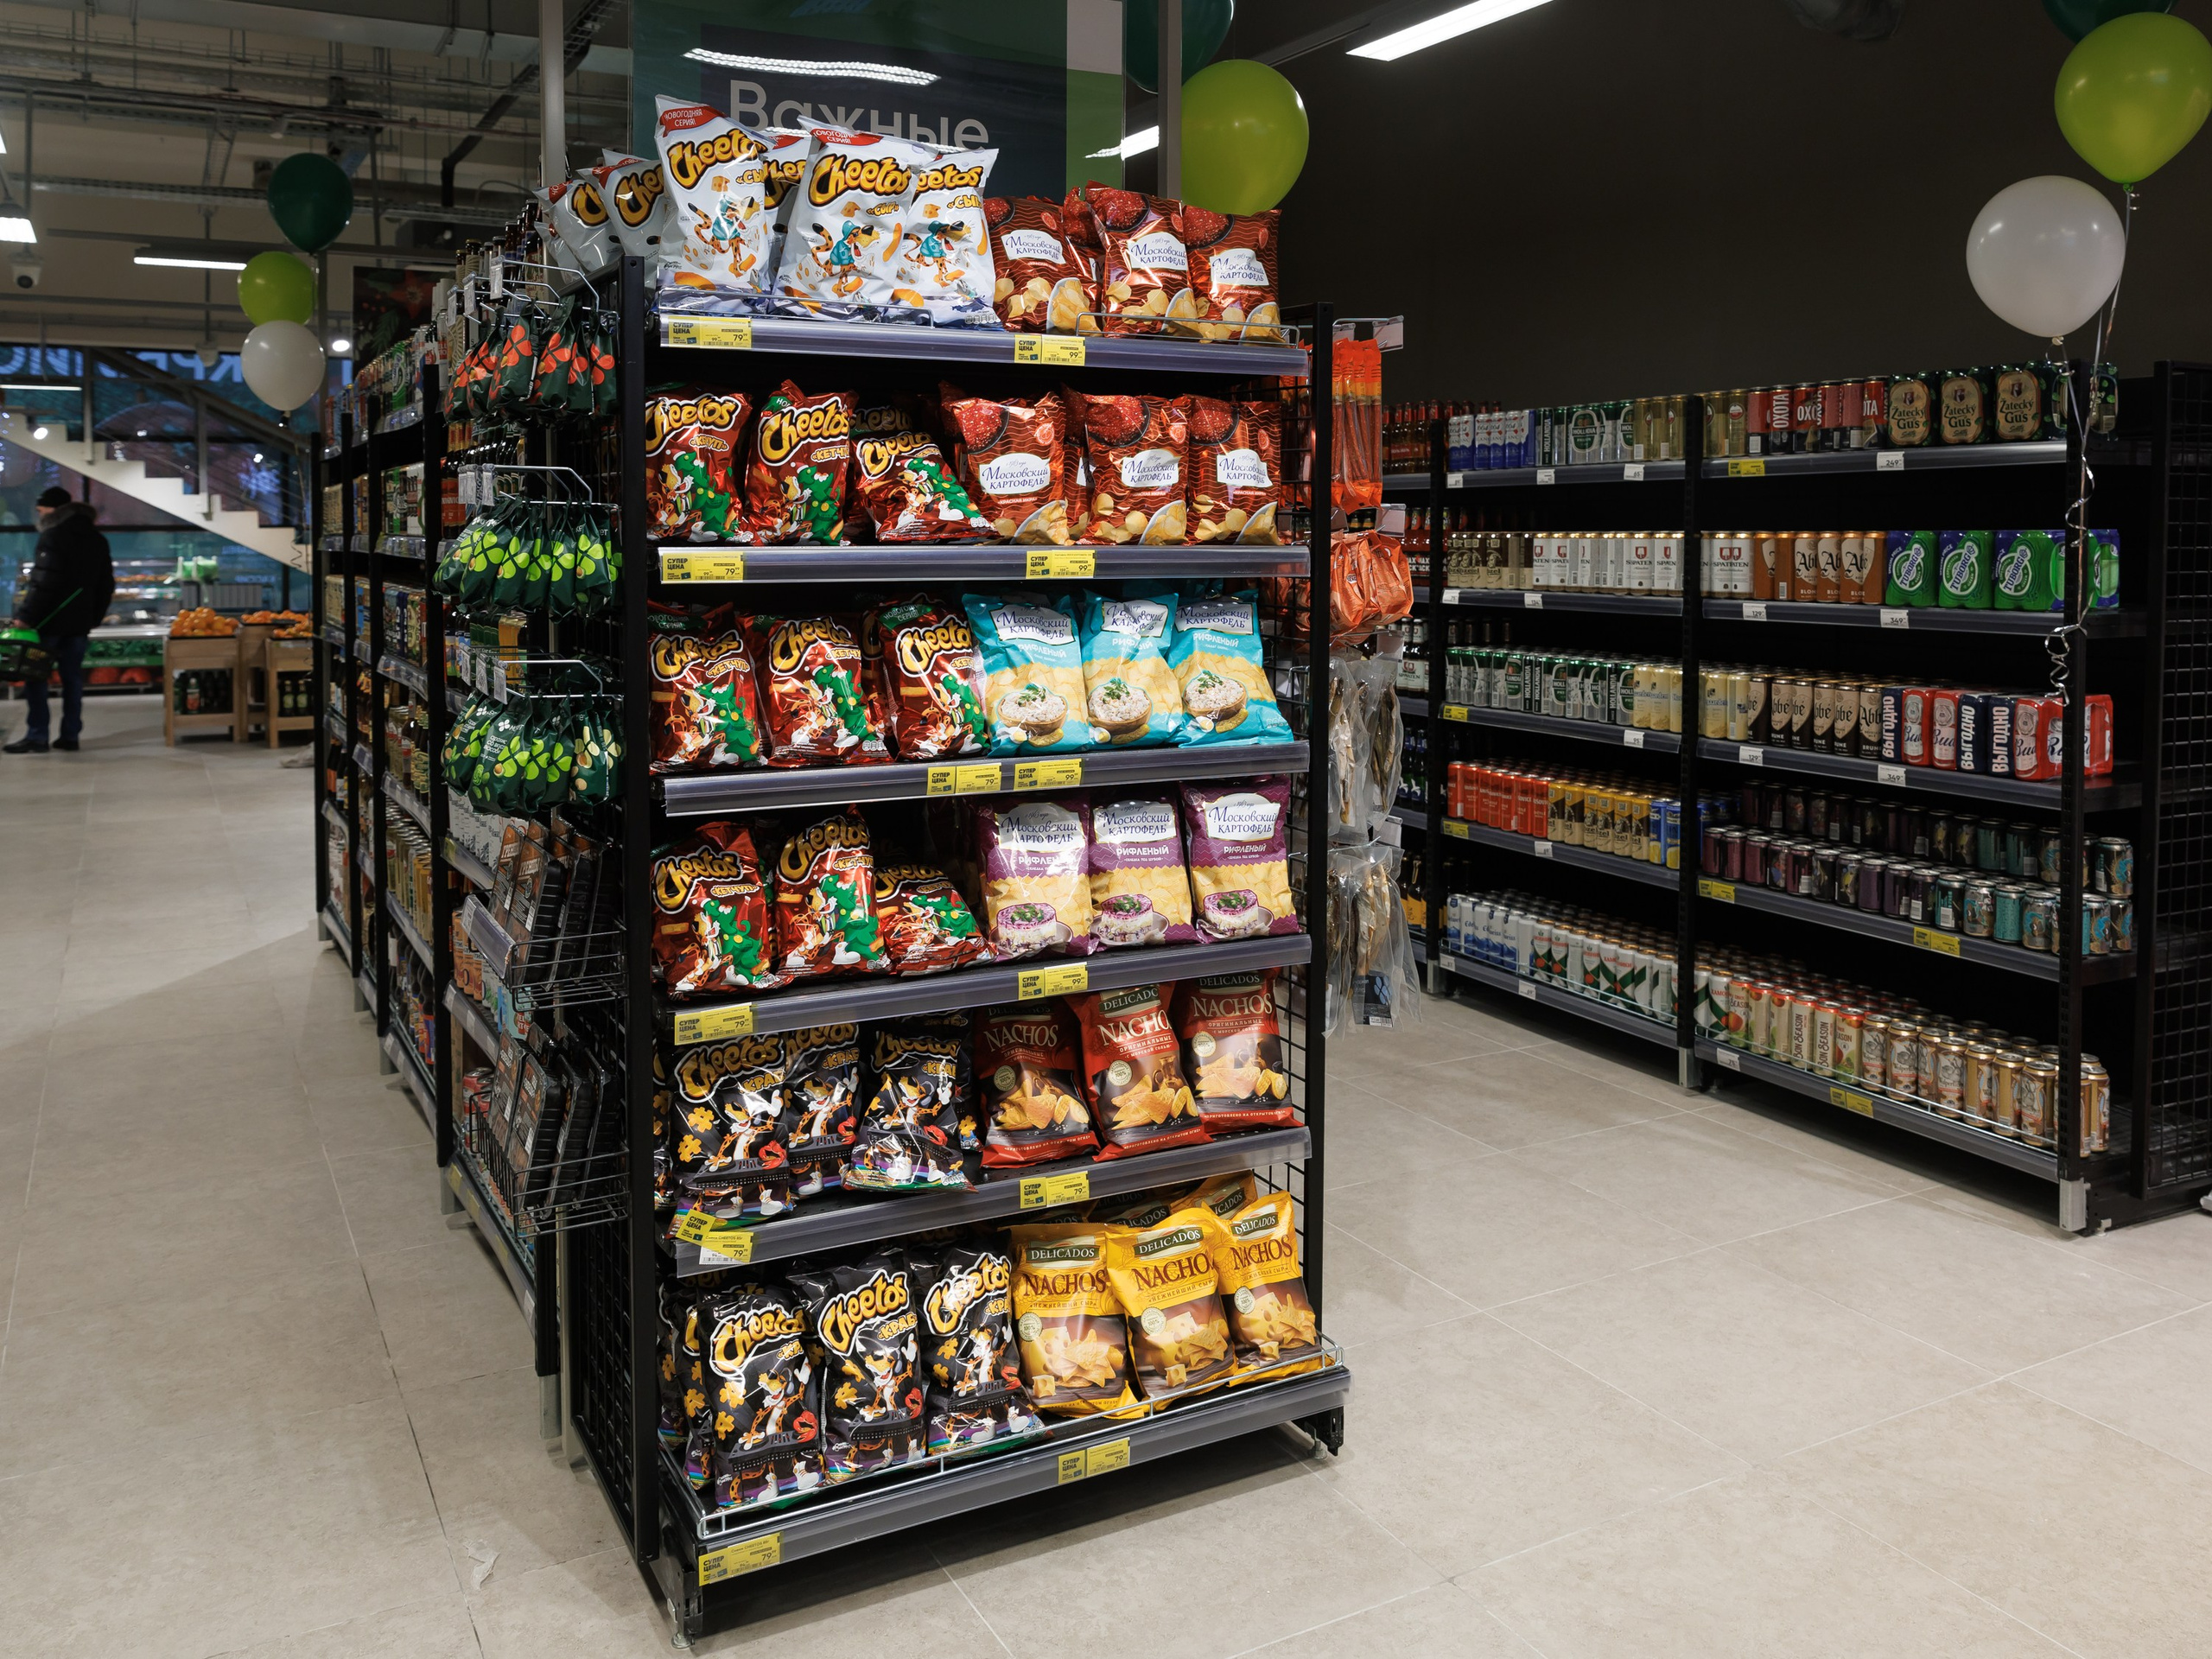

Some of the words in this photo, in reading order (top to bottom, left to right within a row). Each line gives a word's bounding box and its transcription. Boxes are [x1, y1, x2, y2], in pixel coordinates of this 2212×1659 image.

[735, 169, 765, 185] «СЫ
[809, 154, 912, 208] Cheetos
[1005, 235, 1061, 255] Московский
[1015, 247, 1059, 261] КАРТОФЕЛЬ
[1140, 256, 1185, 266] КАРТОФЕЛЬ
[1219, 270, 1264, 283] КАРТОФЕЛЬ
[1772, 393, 1789, 429] ОХОТА
[1797, 405, 1816, 422] ОХО
[1891, 404, 1925, 419] Žatecký
[1944, 404, 1976, 419] Žatecký
[1999, 399, 2034, 414] Žatecký
[1897, 418, 1920, 429] Gus
[1948, 416, 1972, 428] Gus
[2005, 411, 2029, 423] Gus
[1543, 417, 1552, 453] HOLLANDIA
[861, 433, 932, 477] Cheeto
[982, 466, 1048, 481] Московский
[1124, 458, 1176, 474] Московский
[990, 478, 1045, 490] КАРТОФЕЛЬ
[1130, 472, 1172, 483] КАРТОФЕЛЬ
[1900, 555, 1917, 588] TUBORG
[1949, 553, 1972, 590] TUBORG
[2004, 554, 2024, 592] TUBORG
[996, 612, 1069, 628] Московский
[1175, 607, 1249, 620] Московский
[1185, 617, 1245, 628] КАРТОФЕЛЬ
[1009, 626, 1064, 639] КАРТОФЕЛЬ
[1192, 632, 1239, 647] РИФЛЕНЫЙ
[899, 616, 971, 676] Cheeto
[1859, 705, 1881, 726] Abb
[1882, 696, 1898, 758] ВЫГОДНО
[1961, 705, 1975, 770] ВЫГОДНО
[1992, 706, 2010, 772] ВЫГОДНО
[1208, 805, 1277, 823] Московский
[1001, 816, 1077, 833] Московский
[1109, 824, 1166, 836] КАРТОФЕЛЬ
[1217, 823, 1272, 834] КАРТОФЕЛЬ
[1116, 844, 1169, 855] РИФЛЕНЫЙ
[1224, 843, 1267, 854] РИФЛЕНЫЙ
[835, 855, 873, 869] «КЕТЧУП
[654, 849, 741, 912] Cheetos
[1199, 975, 1261, 986] DELICADOS
[1103, 988, 1159, 1010] DELICADO
[1192, 993, 1273, 1017] NACHOS
[1097, 1009, 1173, 1046] NACHO
[1208, 1019, 1262, 1027] ОРИГИНАЛЬНЫЕ
[1795, 1013, 1804, 1046] SEASON
[983, 1024, 1058, 1052] NACHOS
[1819, 1021, 1829, 1051] SEASON
[785, 1023, 859, 1068] heetos
[823, 1047, 859, 1069] «КРАБ
[686, 1221, 701, 1230] ЦЕНА
[689, 1216, 708, 1226] СУПЕР
[1235, 1215, 1275, 1235] DELICADOS
[1139, 1229, 1201, 1254] DELICADOS
[1031, 1248, 1095, 1260] DELICADOS
[1230, 1234, 1293, 1270] NACHOS
[1022, 1269, 1107, 1297] NACHOS
[821, 1272, 907, 1352] Cheetos
[1062, 1457, 1080, 1466] СУПЕР
[1115, 1454, 1123, 1463] 79
[1062, 1463, 1077, 1471] ЦЕНА
[703, 1555, 724, 1566] СУПЕР
[761, 1552, 772, 1561] 79
[703, 1563, 721, 1572] ЦЕНА
